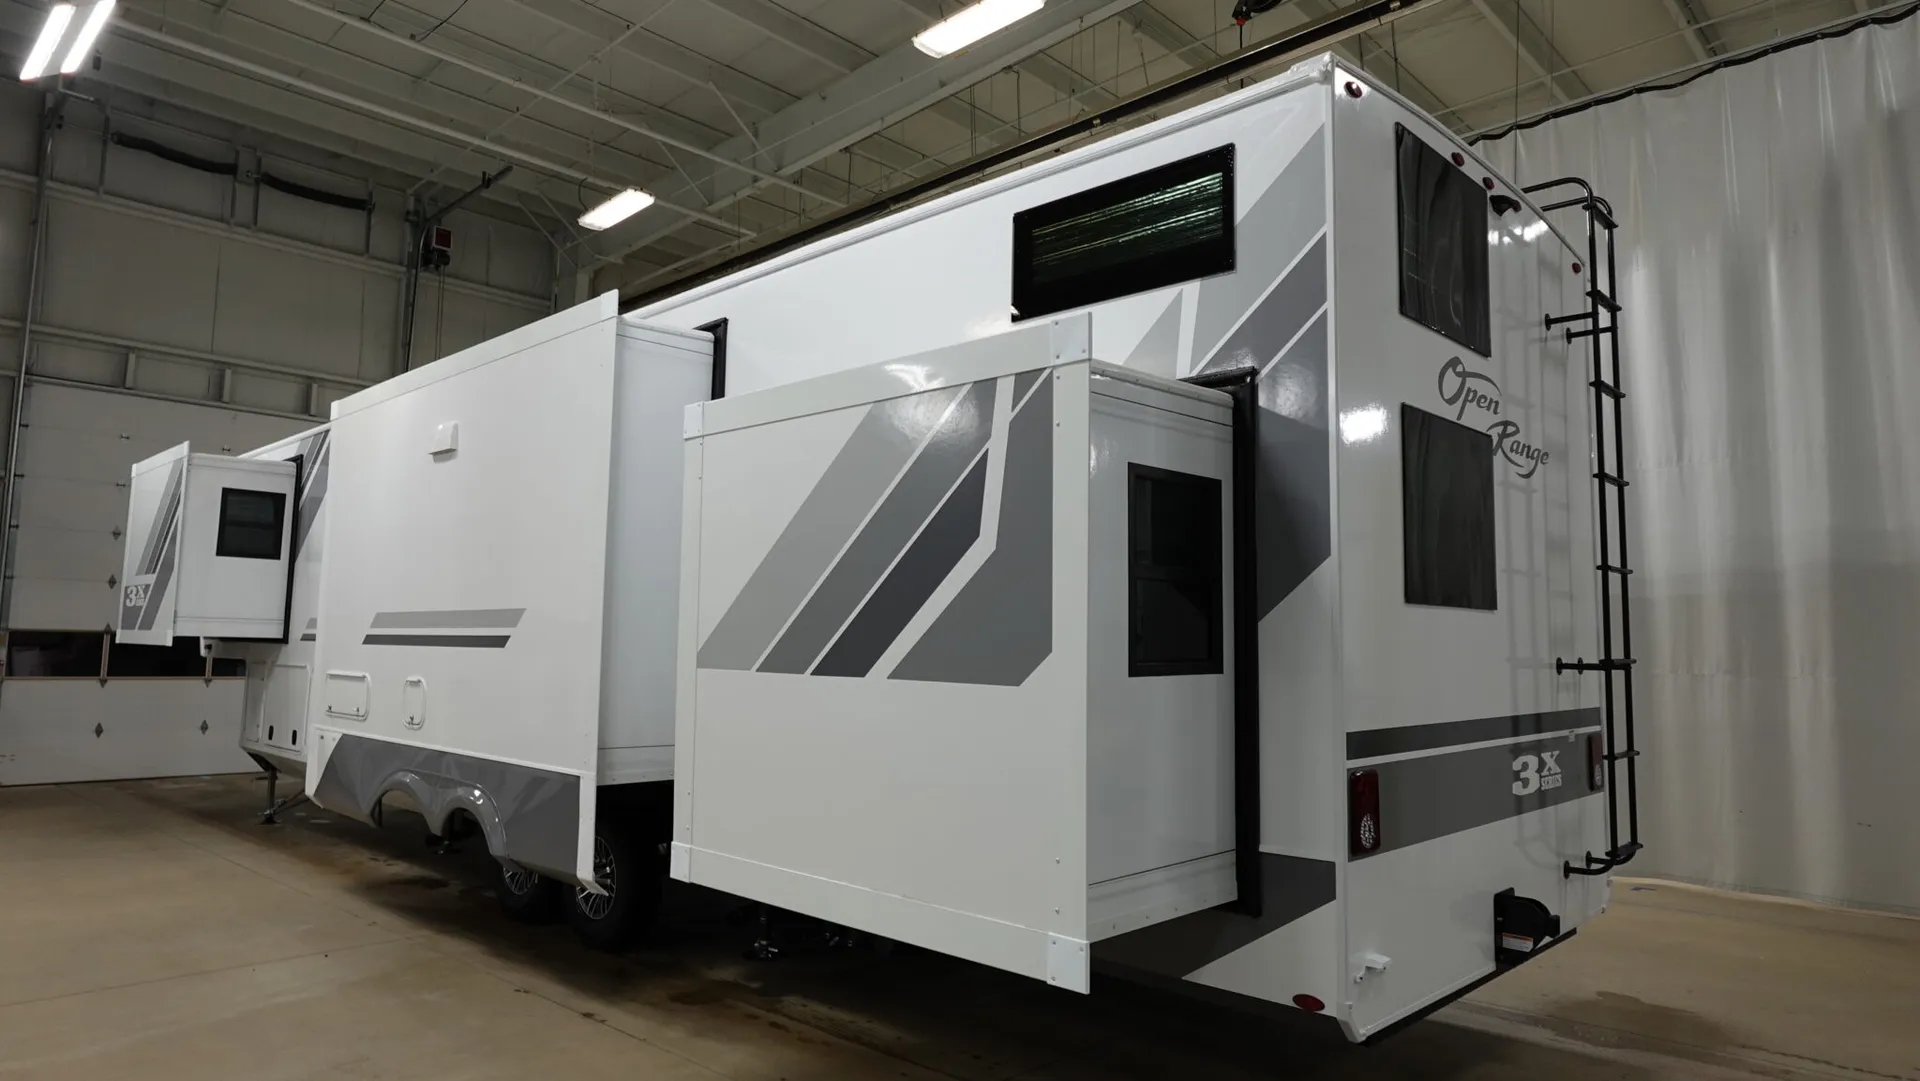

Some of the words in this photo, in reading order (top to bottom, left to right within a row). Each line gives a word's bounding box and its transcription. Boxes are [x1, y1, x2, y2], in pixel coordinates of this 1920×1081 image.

[1438, 356, 1502, 421] Open
[1486, 420, 1549, 479] Range
[1512, 750, 1561, 796] 3X
